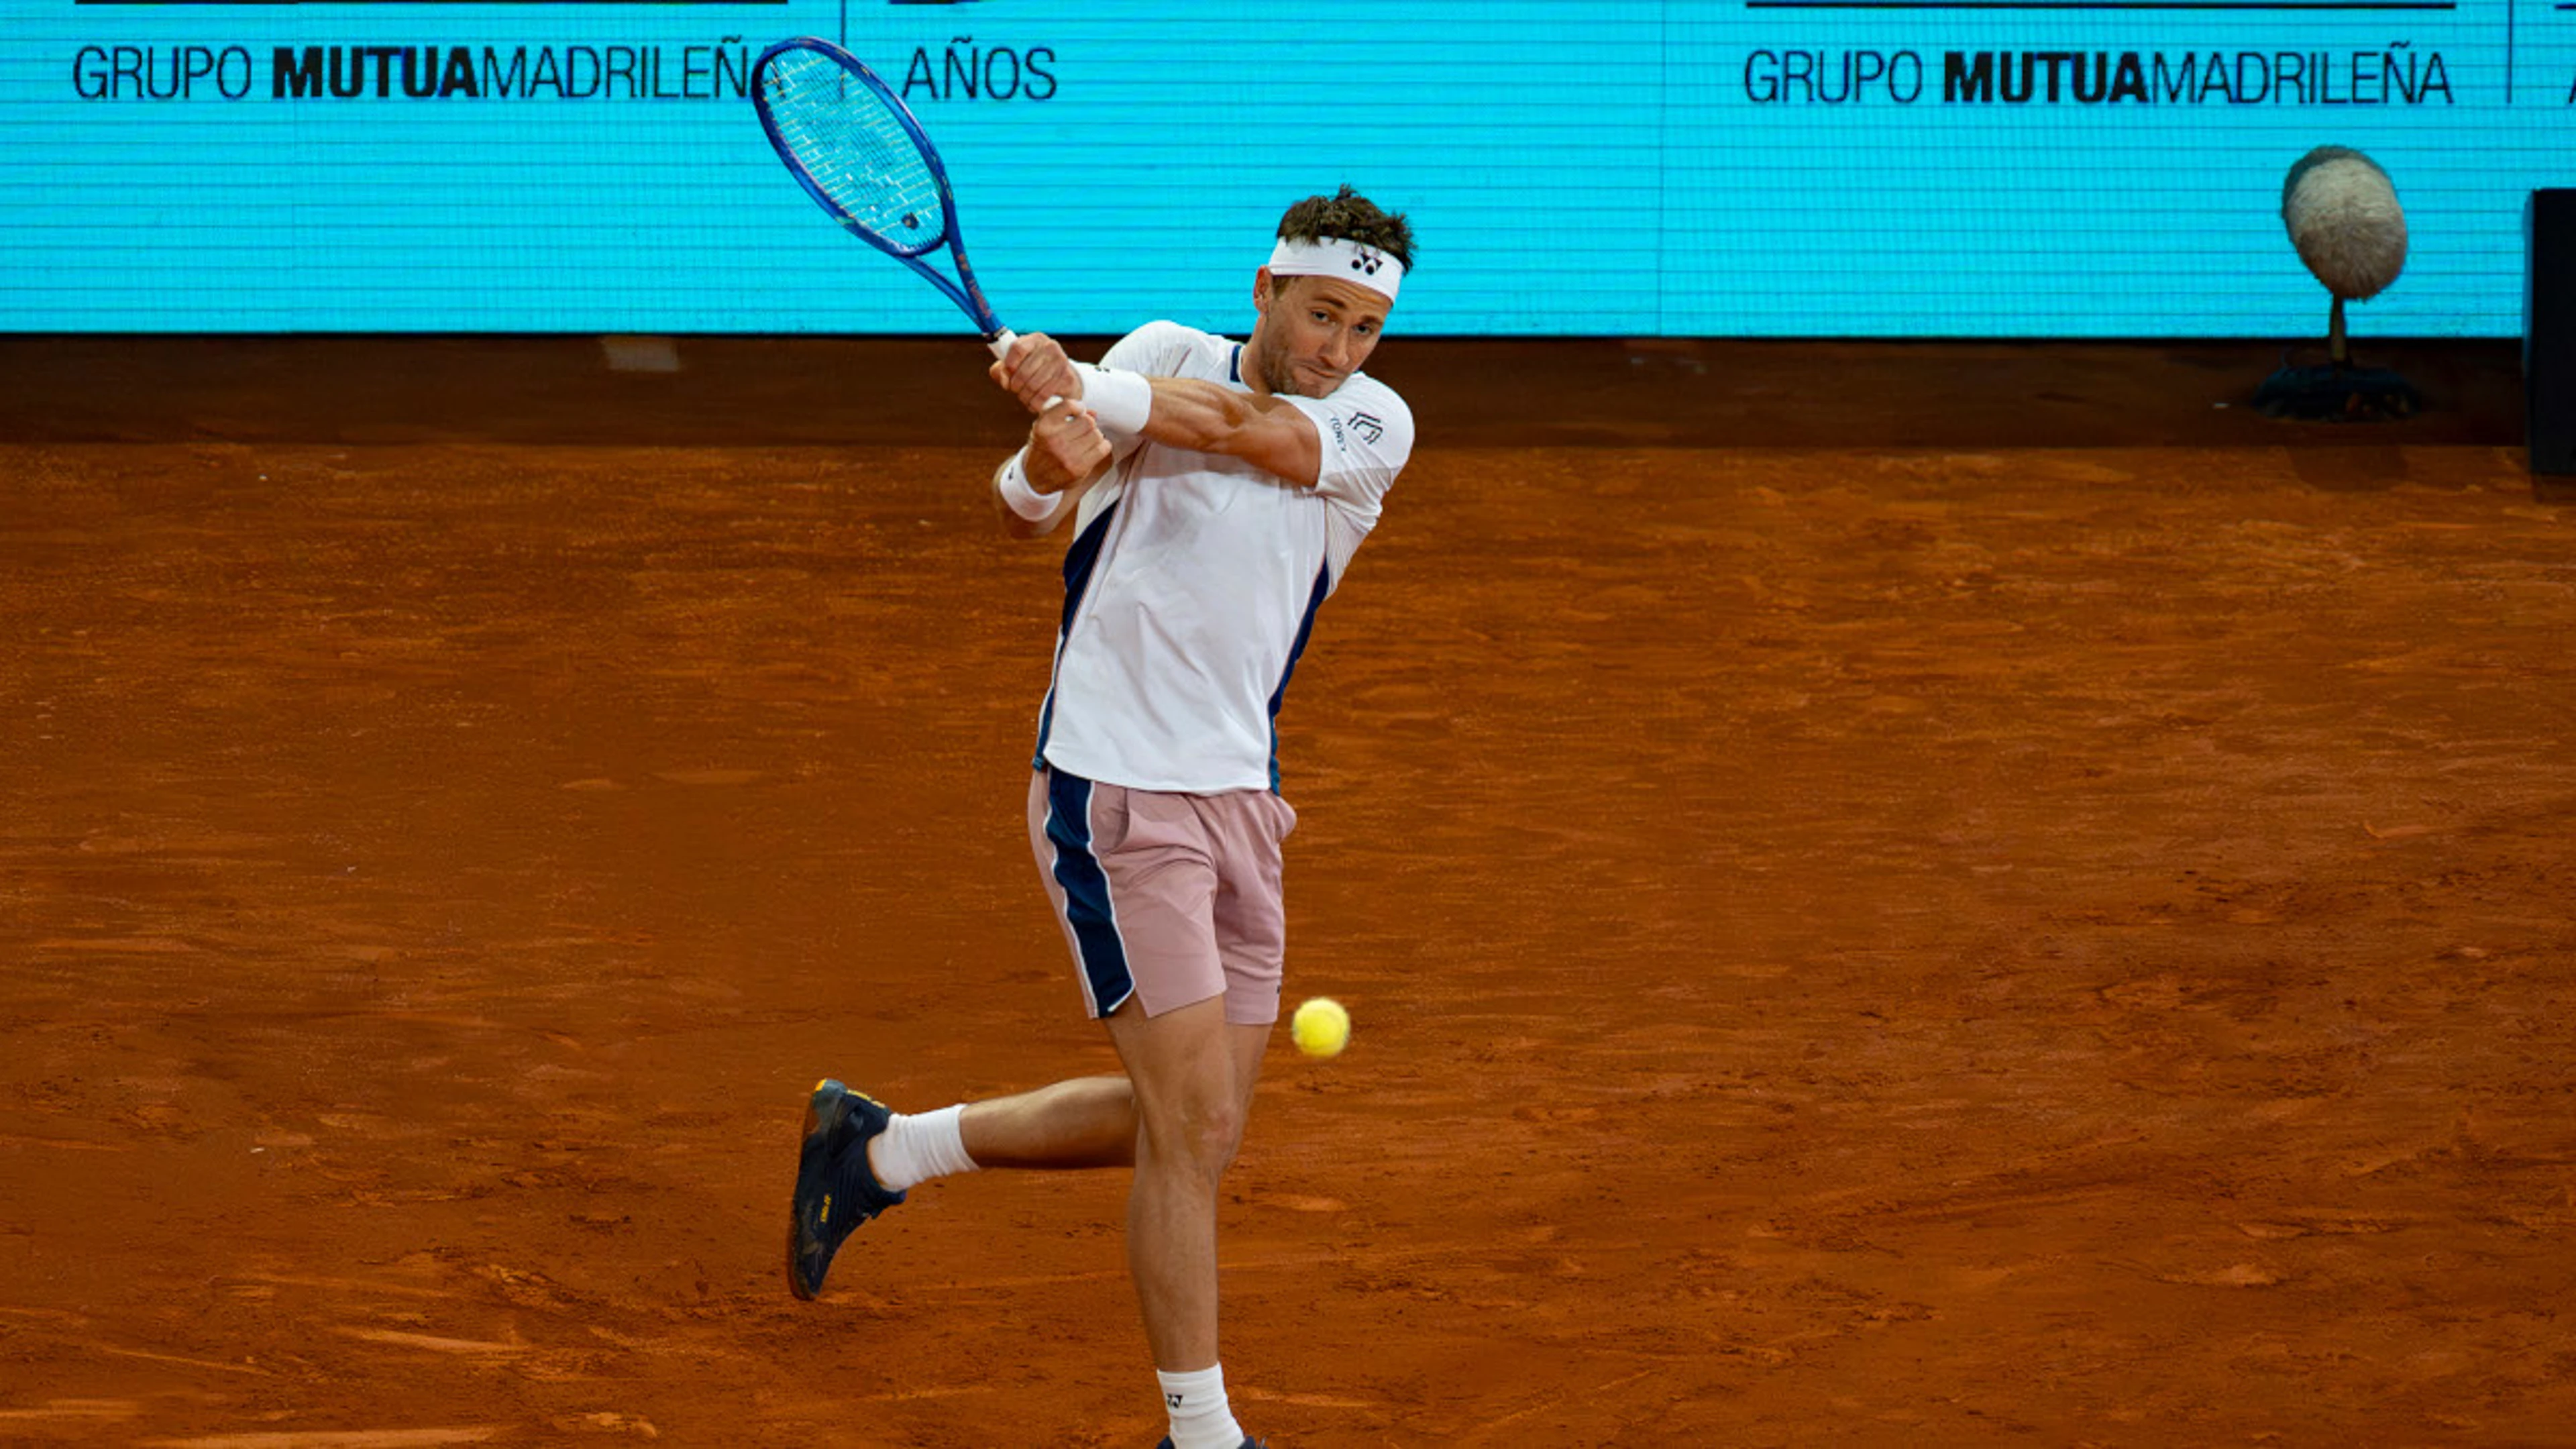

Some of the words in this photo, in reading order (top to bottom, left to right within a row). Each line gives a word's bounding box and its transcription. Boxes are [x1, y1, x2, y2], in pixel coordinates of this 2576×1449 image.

[72, 46, 252, 100] GRUPO
[902, 36, 1057, 100] AÑOS
[1744, 50, 1923, 103] GRUPO
[1943, 41, 2454, 105] MUTUAMADRILEÑA
